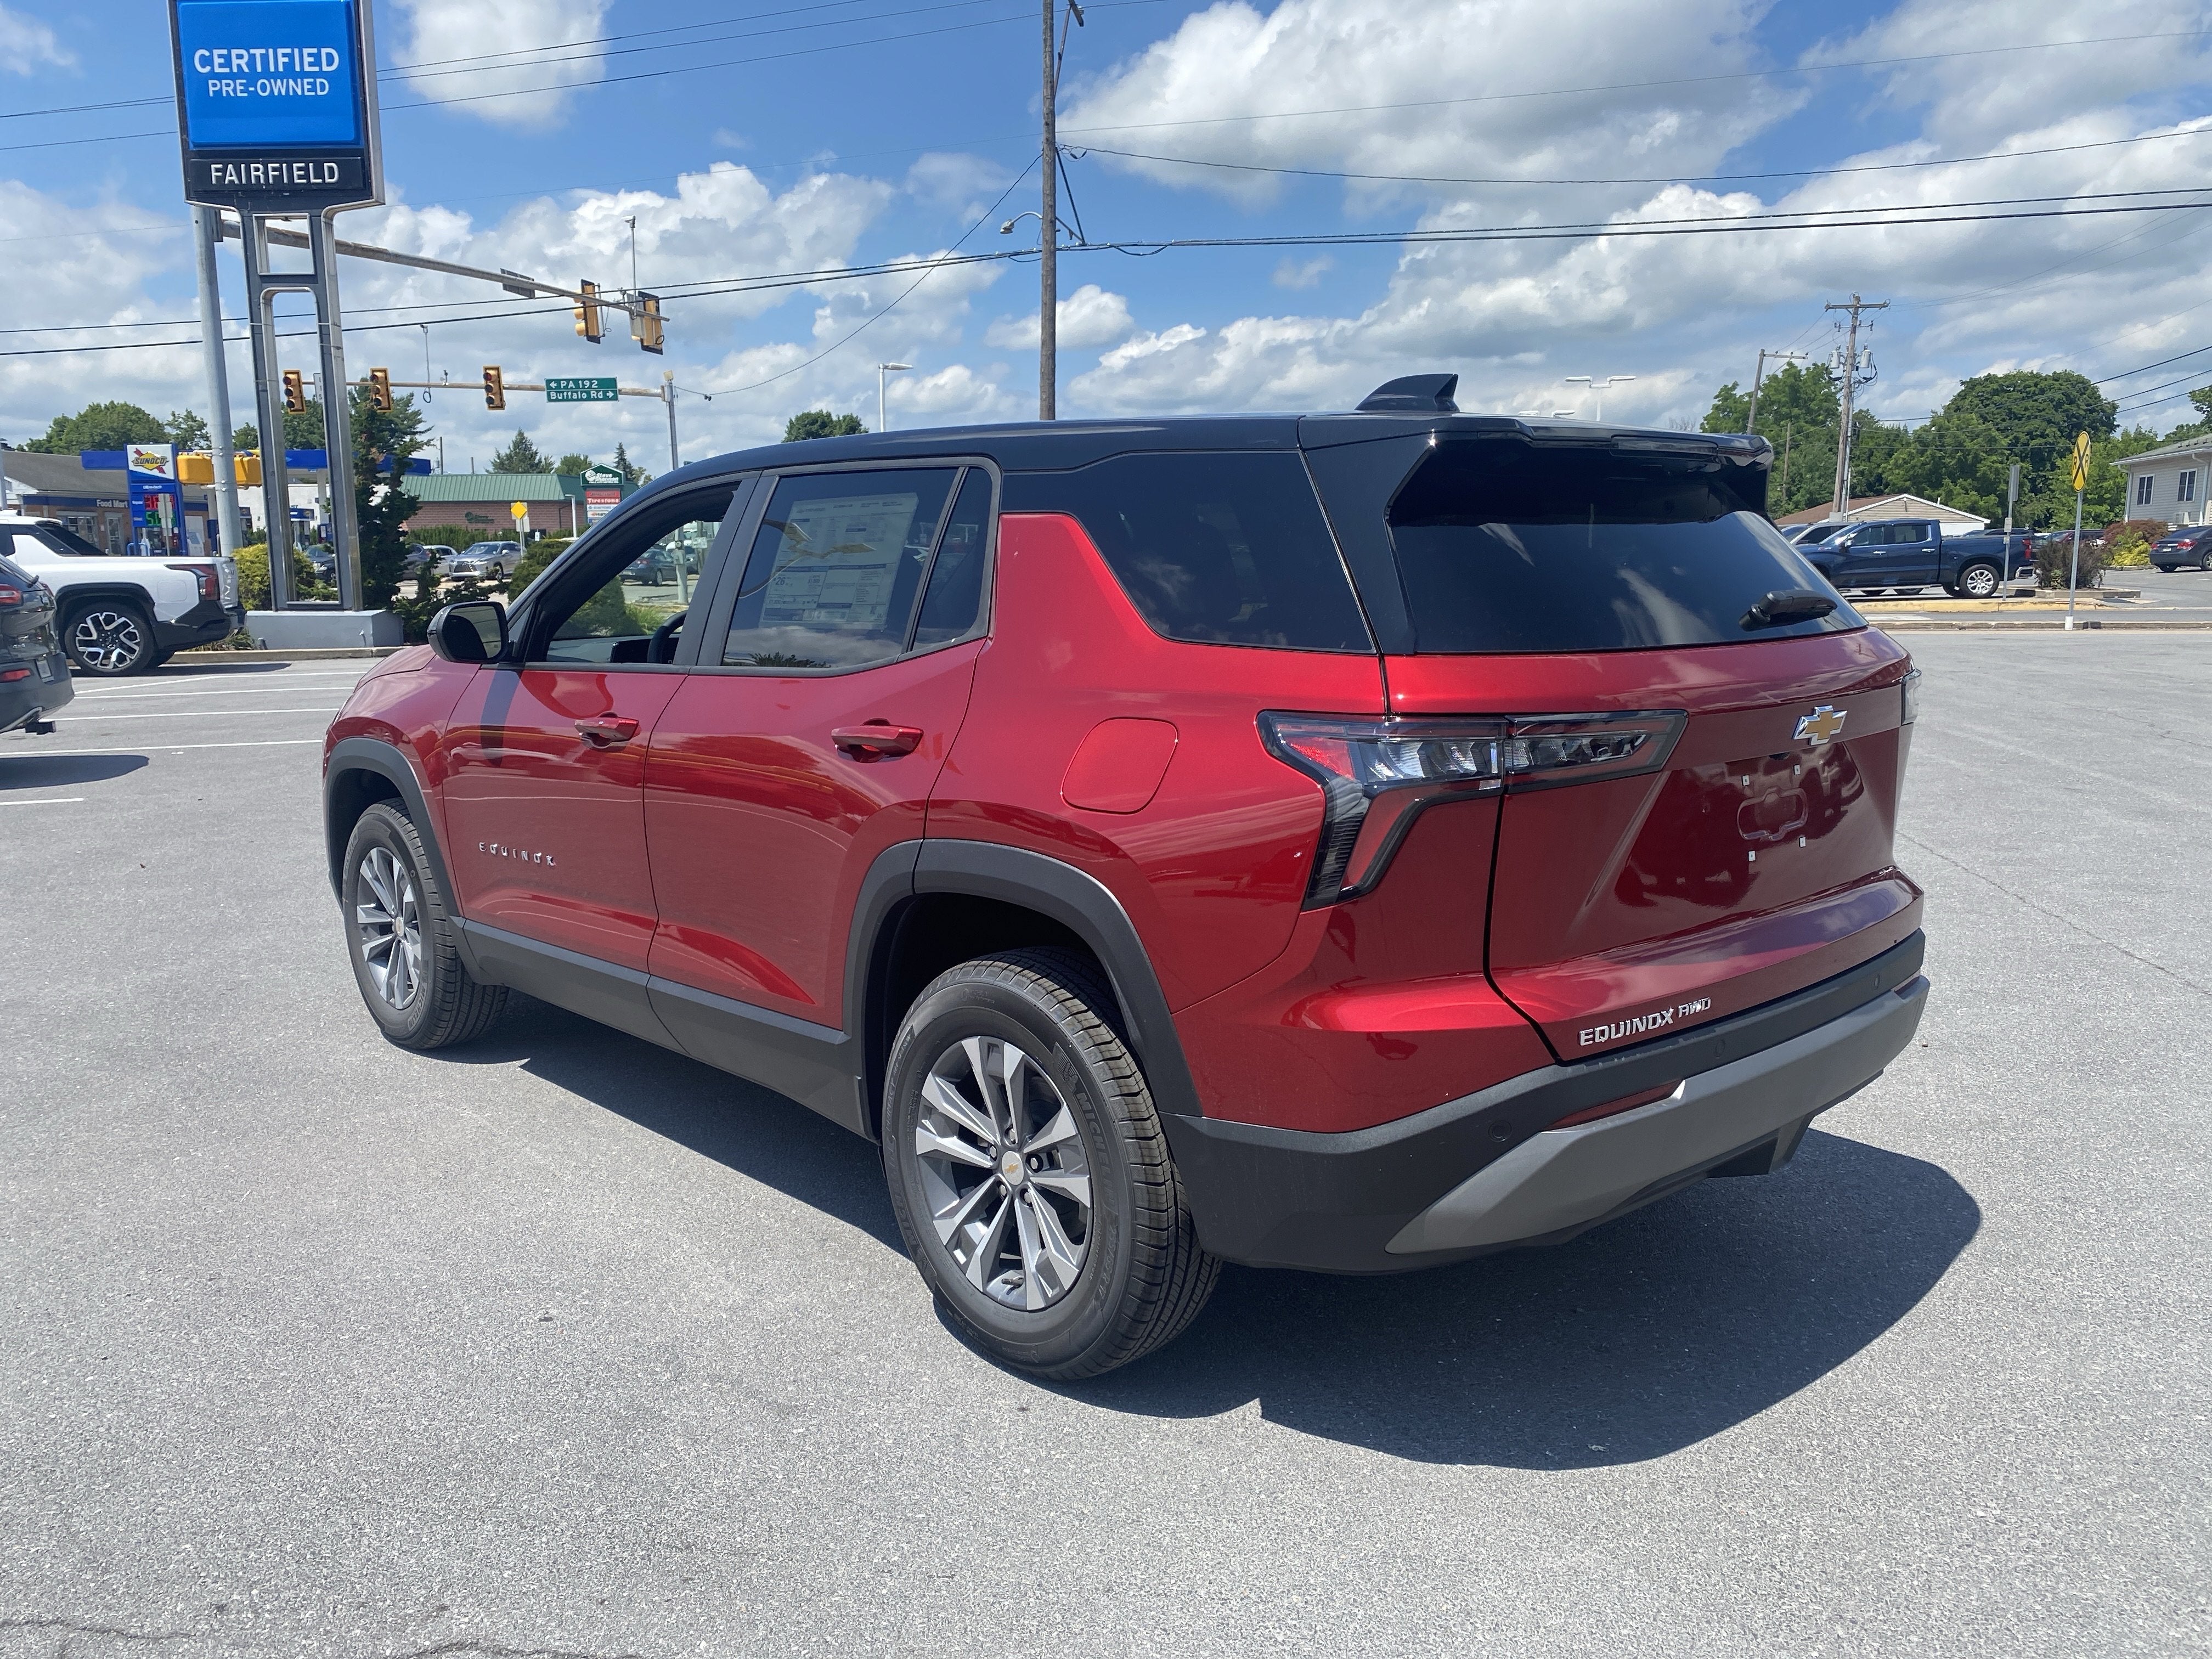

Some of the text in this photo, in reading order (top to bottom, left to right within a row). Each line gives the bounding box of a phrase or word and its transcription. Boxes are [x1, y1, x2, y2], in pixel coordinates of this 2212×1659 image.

[194, 48, 339, 73] CERTIFIED
[208, 78, 329, 97] PRE-OWNED
[211, 162, 339, 185] FAIRFIELD
[578, 380, 598, 388] 192
[550, 391, 586, 399] Buffalo
[113, 500, 128, 508] Mart
[775, 577, 785, 585] 26
[479, 842, 556, 866] EQUINOX
[1579, 997, 1711, 1046] EQUINOX AWD
[1077, 1093, 1114, 1206] MICHELIN
